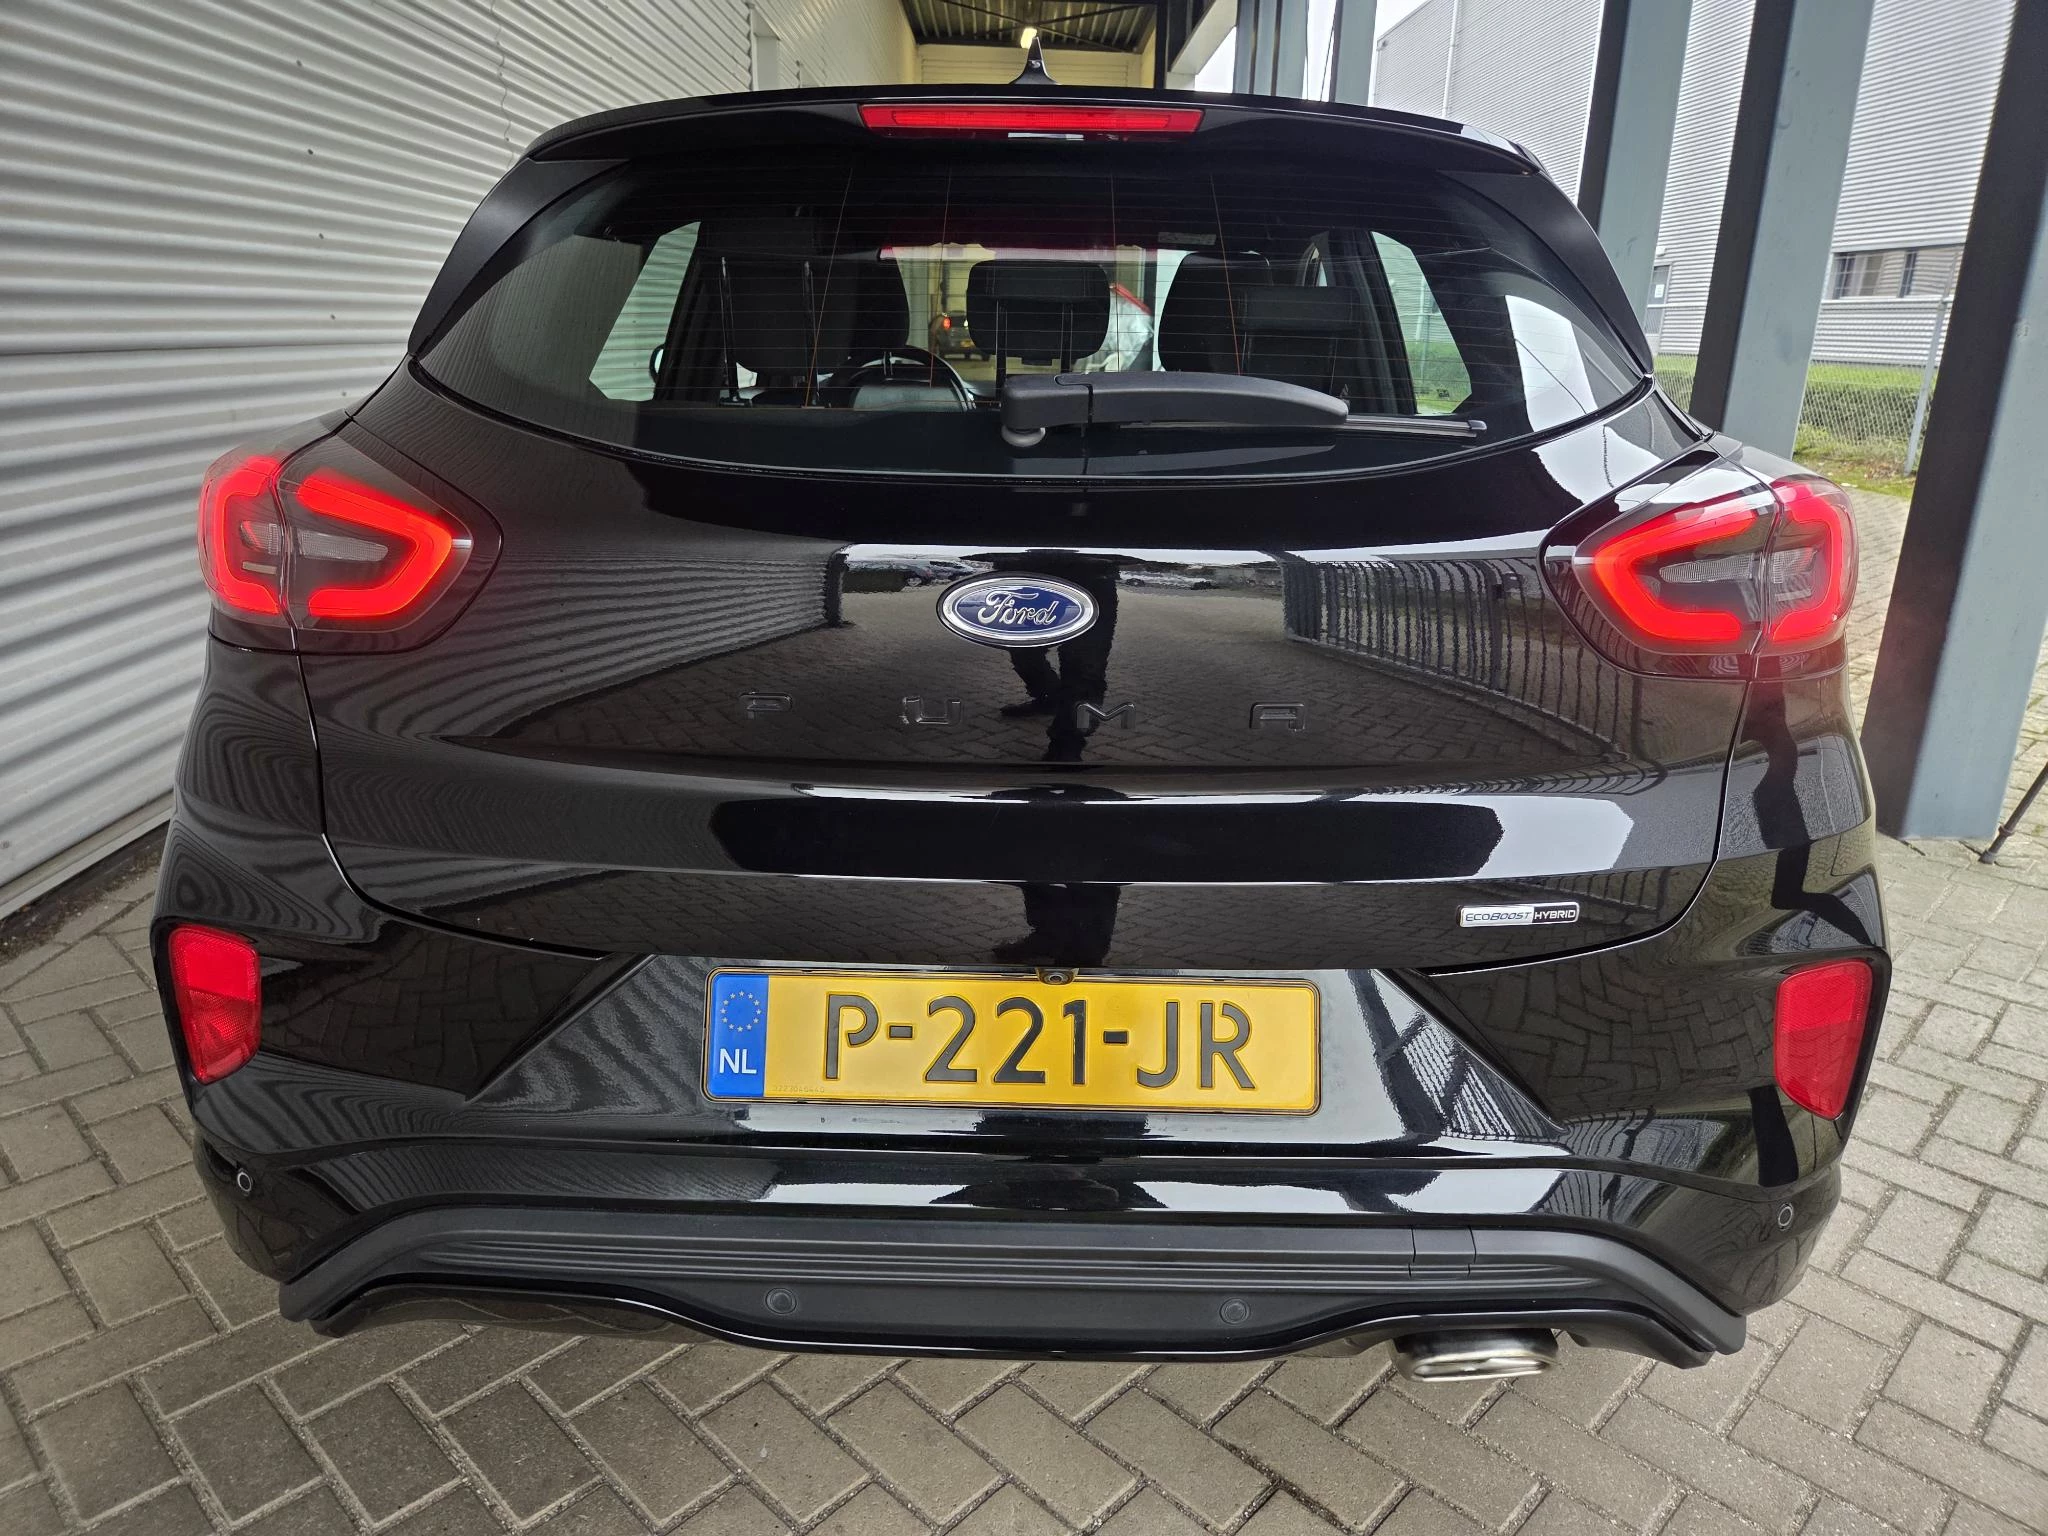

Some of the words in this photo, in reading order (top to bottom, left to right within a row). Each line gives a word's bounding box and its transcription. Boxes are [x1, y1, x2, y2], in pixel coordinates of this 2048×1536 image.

[977, 590, 1059, 625] Ford
[739, 690, 1306, 733] PUMA
[1465, 911, 1531, 921] ECOBOOST
[1534, 909, 1576, 920] HYBRID
[825, 993, 1256, 1089] P-221-JR
[719, 1048, 757, 1074] NL
